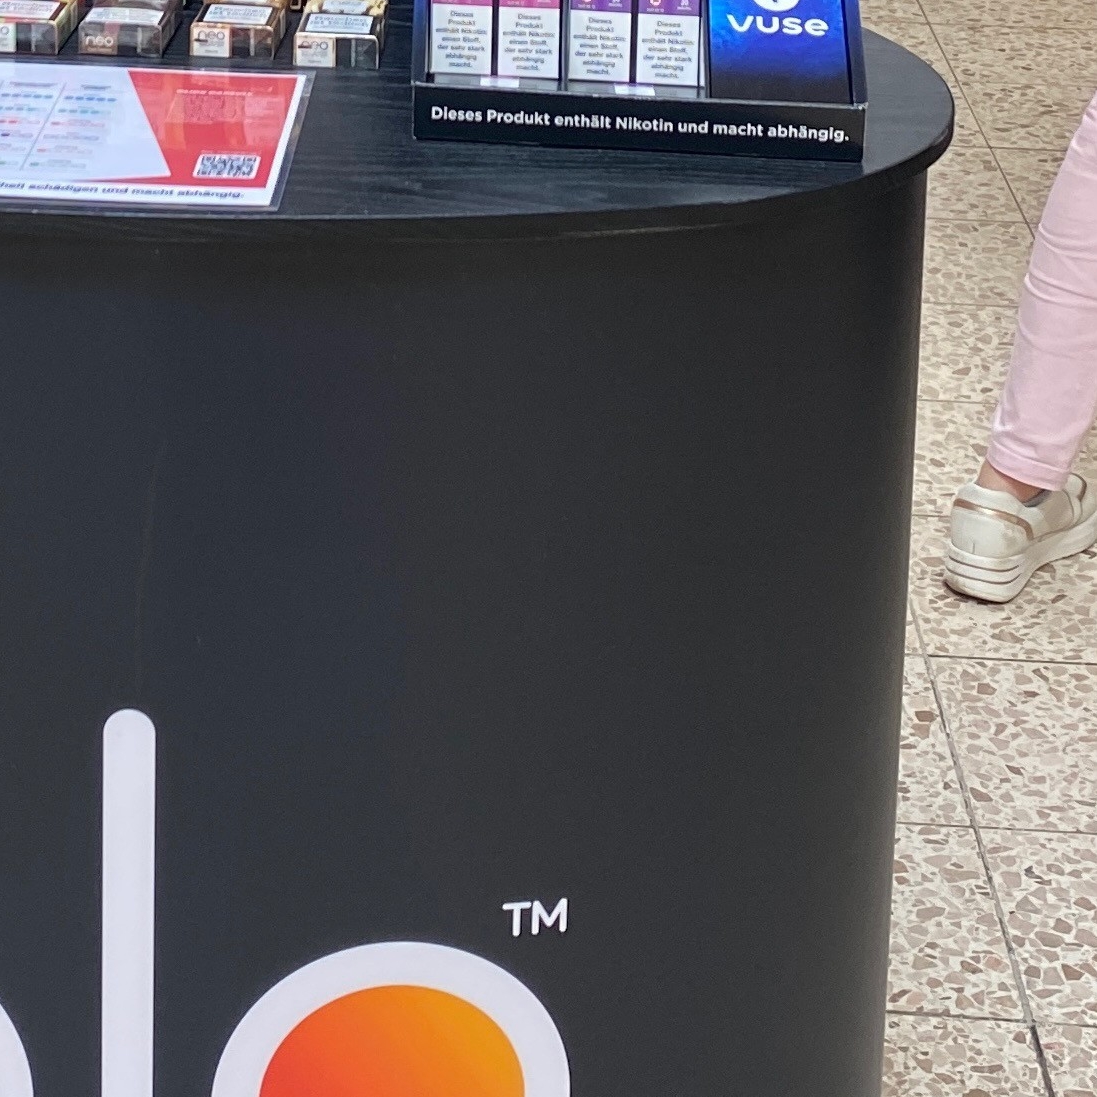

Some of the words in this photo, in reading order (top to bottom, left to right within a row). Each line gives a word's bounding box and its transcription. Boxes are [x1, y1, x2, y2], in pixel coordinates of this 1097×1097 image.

[431, 105, 483, 123] Dieses
[486, 109, 551, 127] Produkt
[554, 112, 611, 131] enthält
[615, 116, 674, 134] Nikotin
[677, 119, 708, 135] und
[713, 121, 763, 138] macht
[768, 123, 850, 144] abhängig.
